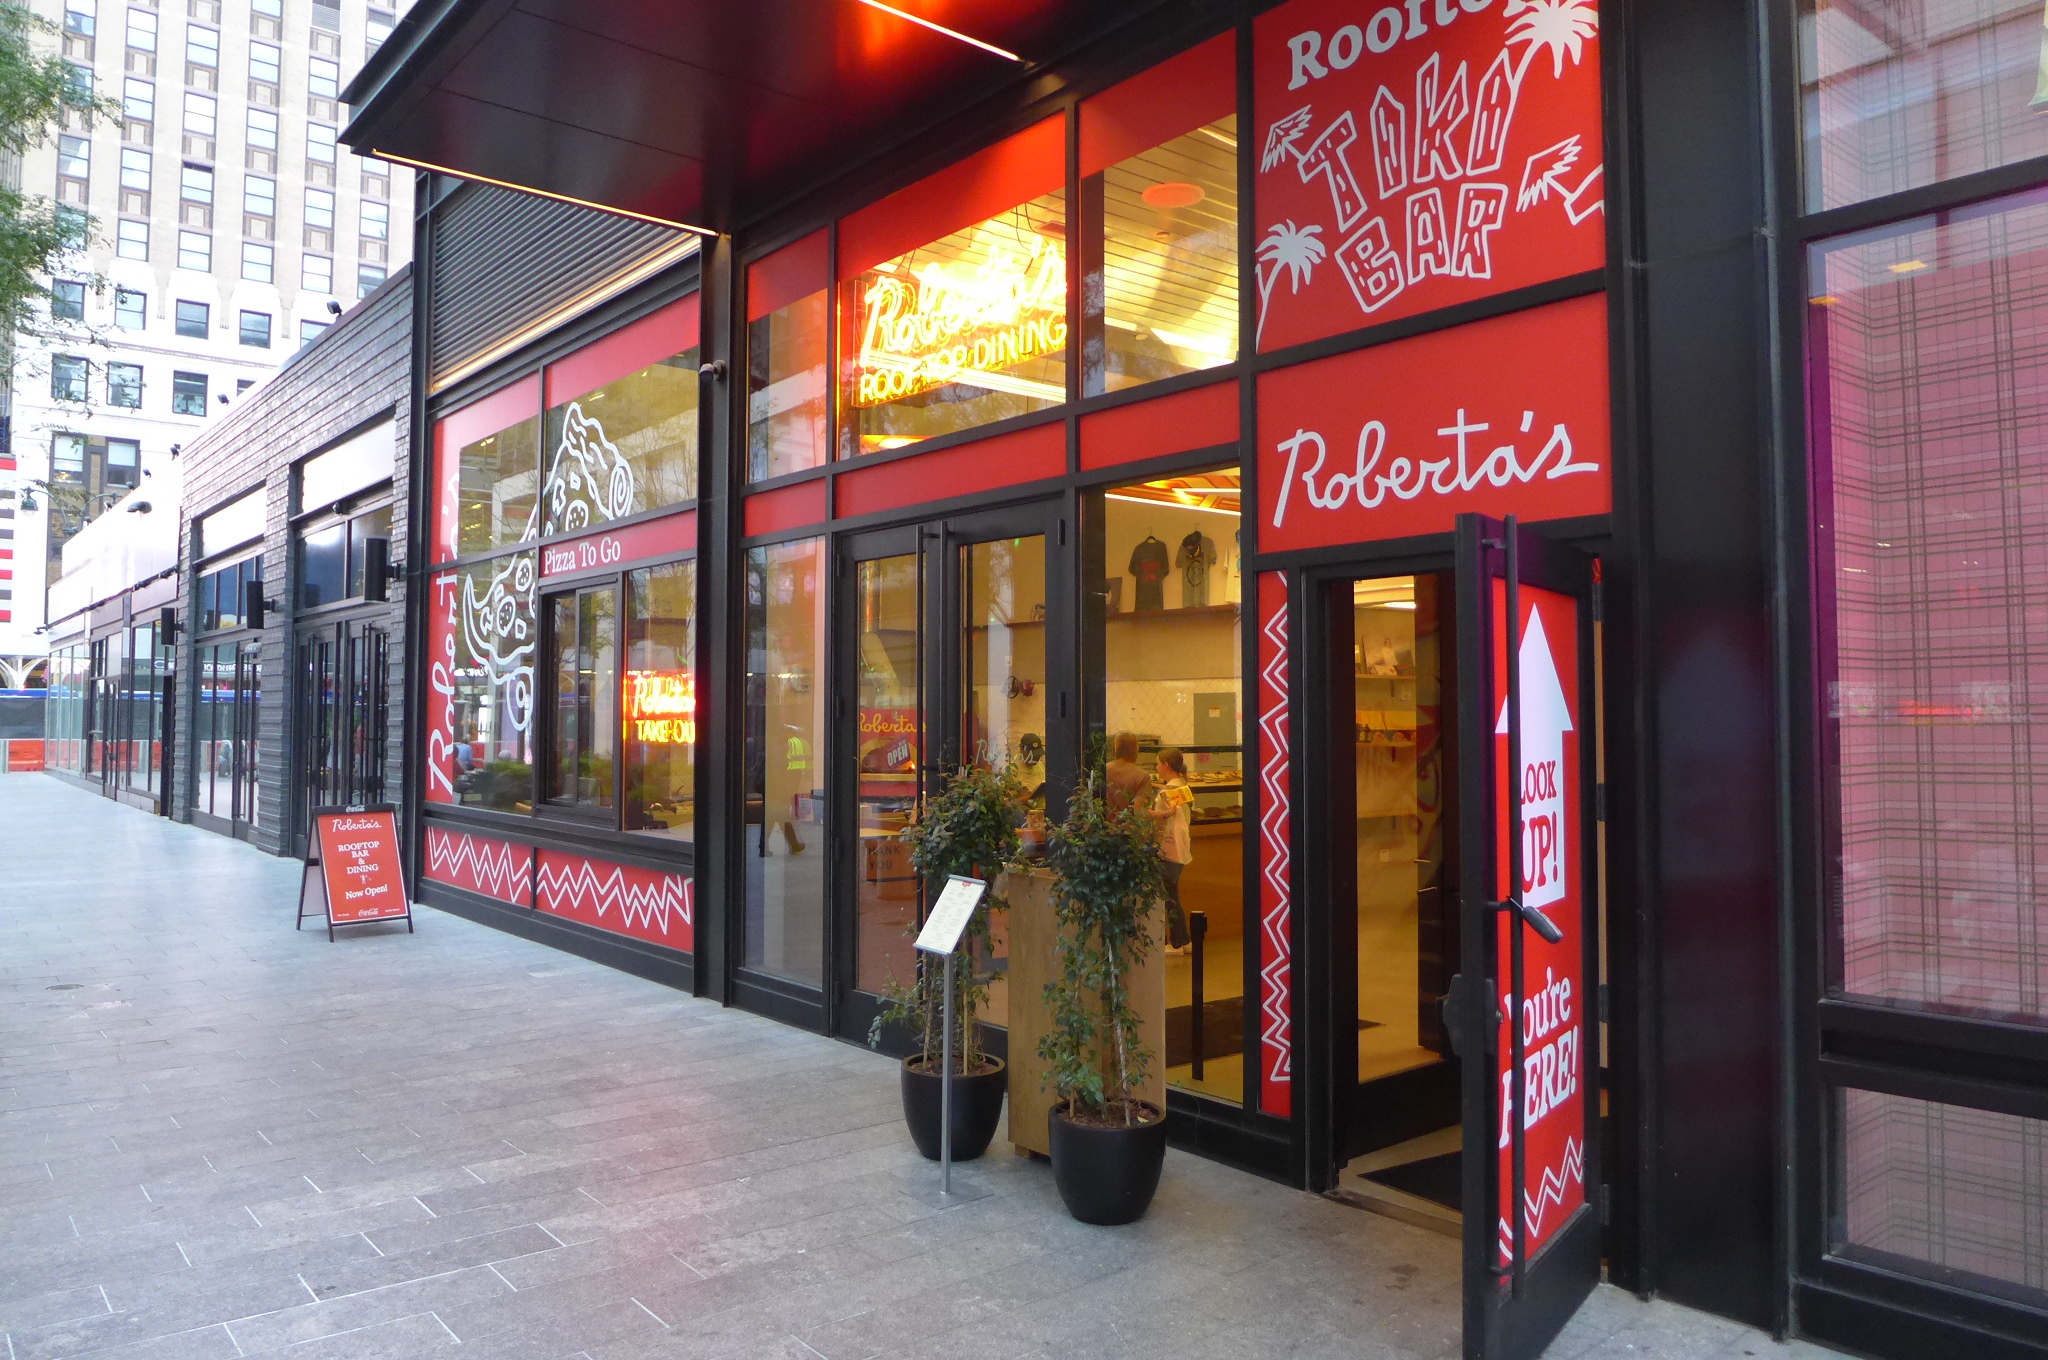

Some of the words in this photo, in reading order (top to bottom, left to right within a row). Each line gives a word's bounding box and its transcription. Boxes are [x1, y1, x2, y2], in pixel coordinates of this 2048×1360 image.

[1287, 0, 1528, 90] Roof
[1297, 48, 1518, 232] TIKI
[1335, 183, 1508, 313] BAR
[974, 312, 1067, 371] DINING
[1273, 408, 1599, 528] Roberta's
[544, 548, 576, 575] Pizza
[579, 541, 597, 567] To
[600, 536, 621, 563] Go
[635, 719, 695, 743] TAKE-OU
[887, 743, 909, 767] OPEN
[1520, 760, 1557, 805] OOK
[332, 818, 382, 832] Roberta's
[338, 841, 380, 852] ROOFTOP
[351, 849, 369, 858] BAR
[1521, 811, 1558, 893] UP!
[346, 863, 379, 874] DINING
[345, 890, 364, 900] Now
[364, 884, 388, 896] Open!
